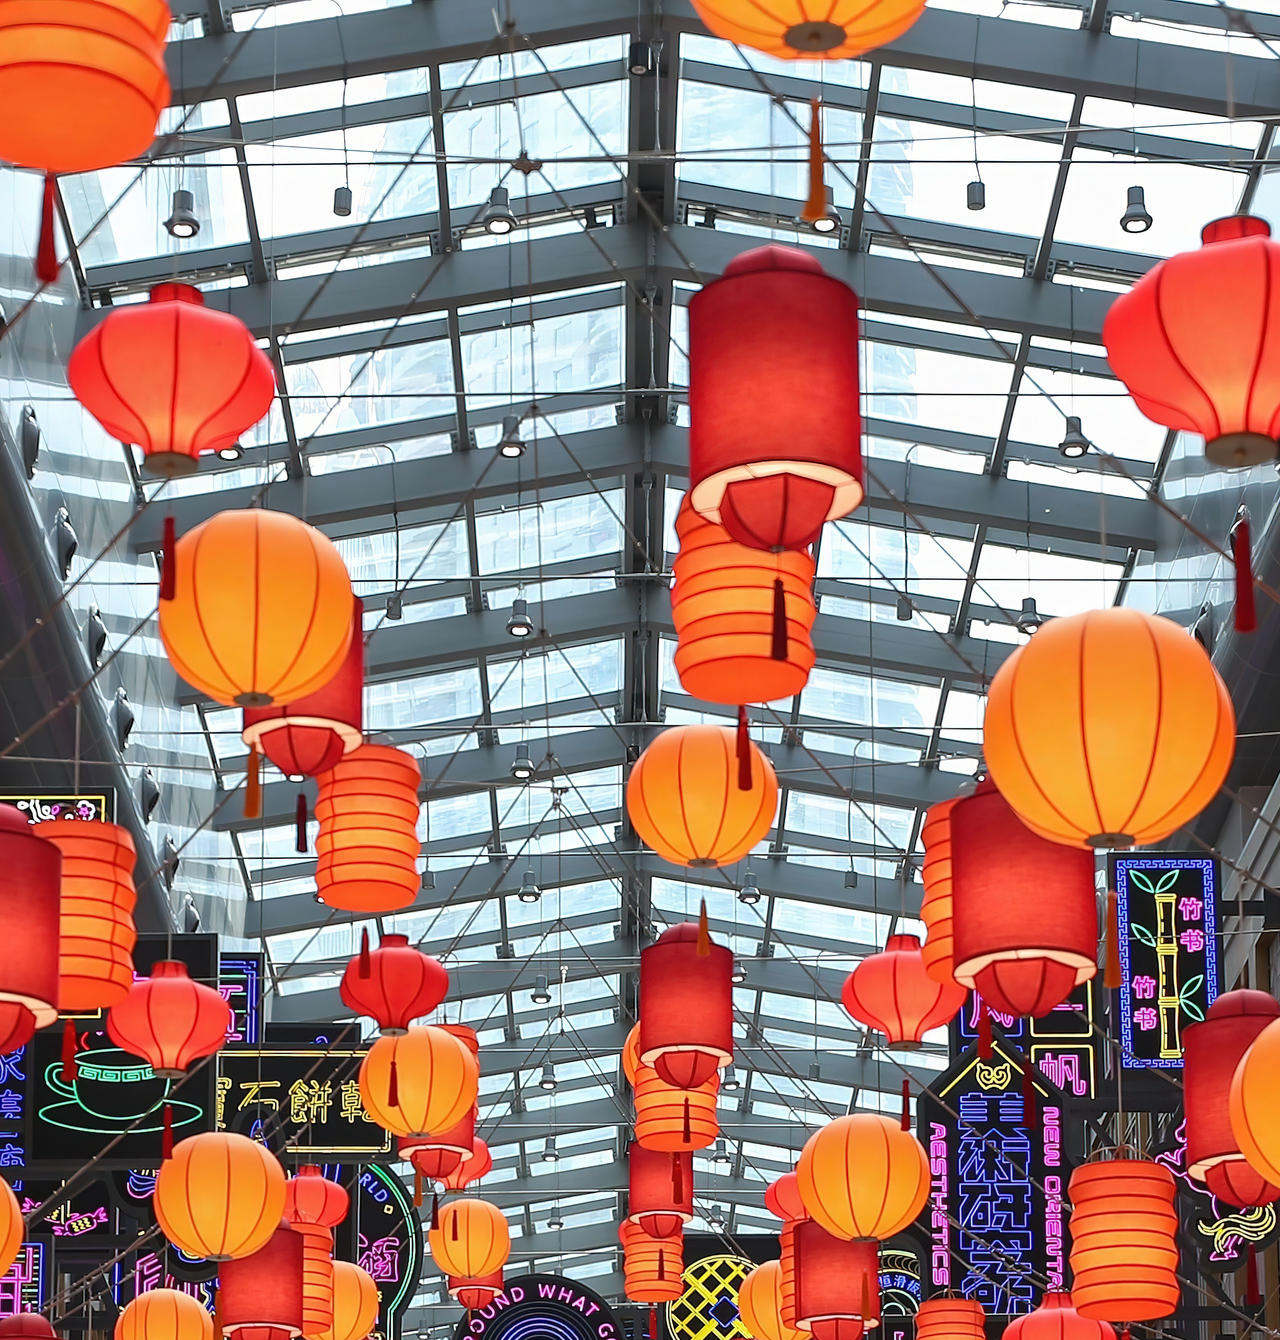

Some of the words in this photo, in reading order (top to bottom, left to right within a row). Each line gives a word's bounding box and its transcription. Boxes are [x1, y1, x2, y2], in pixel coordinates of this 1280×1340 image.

[1042, 1106, 1061, 1167] NEW
[358, 1172, 389, 1203] RLD
[929, 1121, 950, 1287] AESTHETICS
[1044, 1175, 1064, 1293] ORIENTA
[538, 1284, 600, 1316] WHAT
